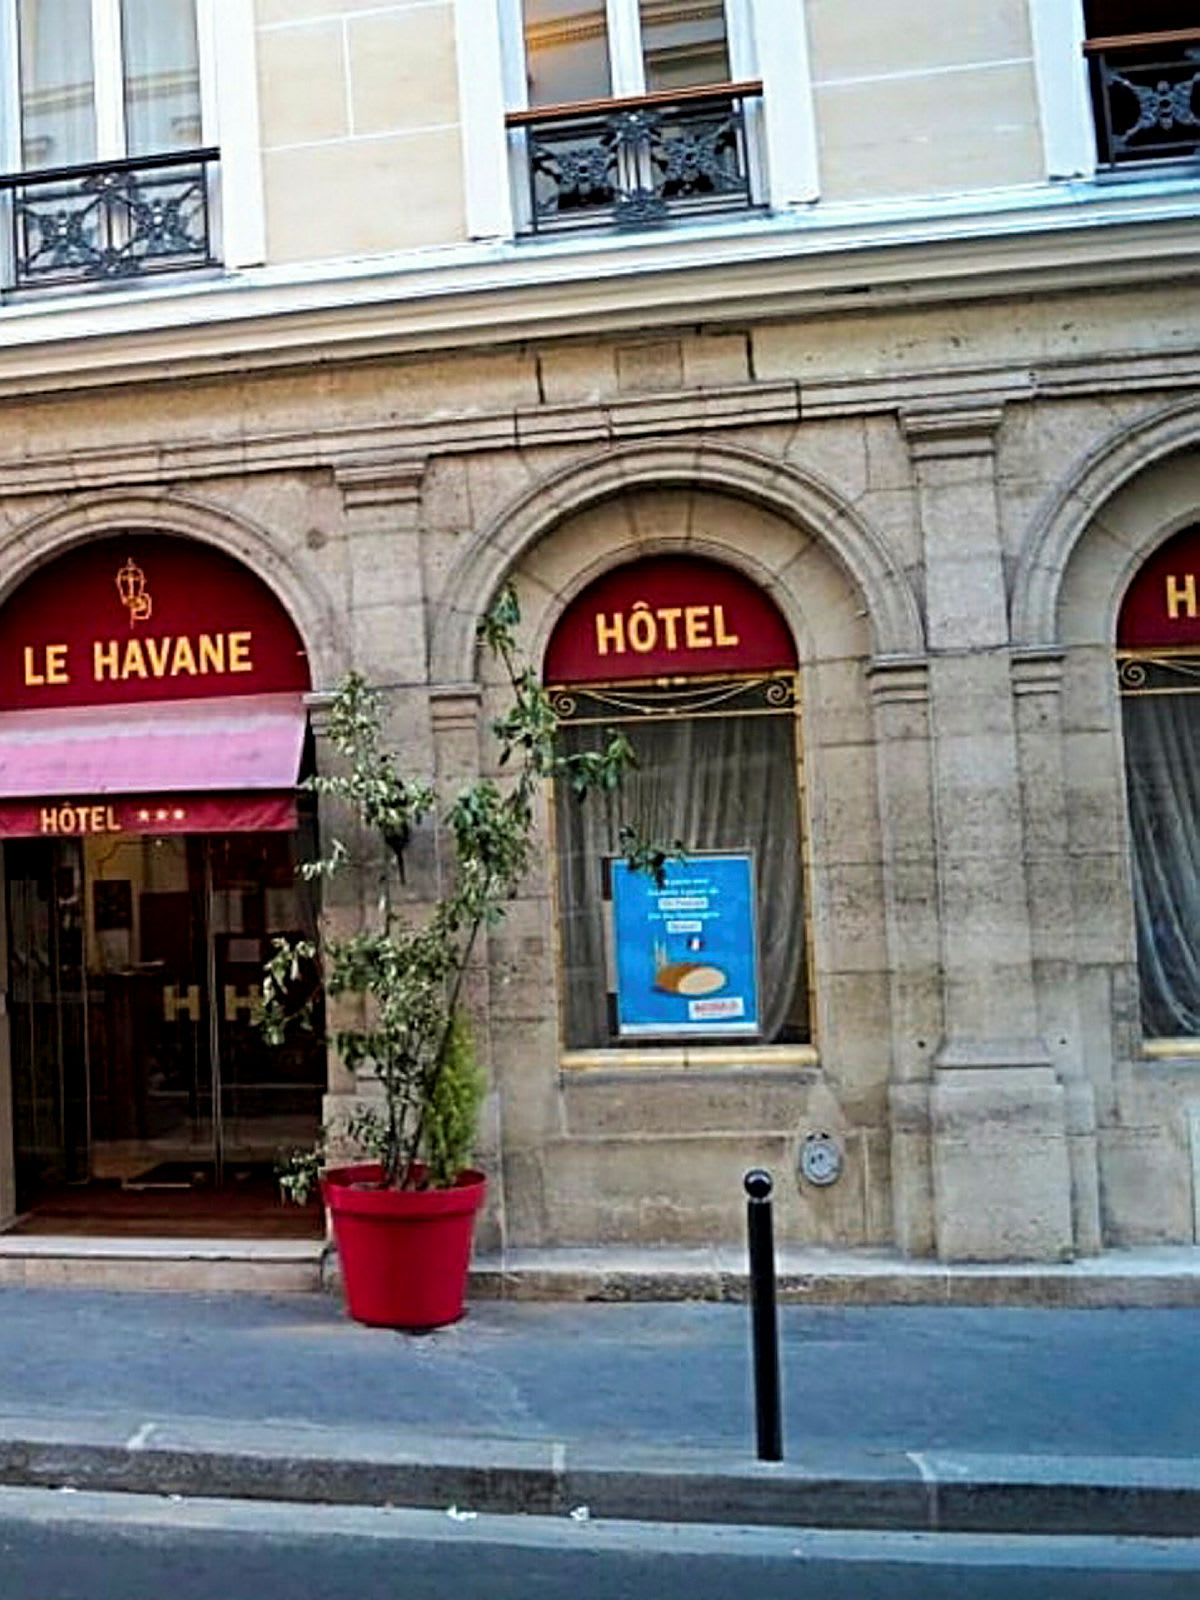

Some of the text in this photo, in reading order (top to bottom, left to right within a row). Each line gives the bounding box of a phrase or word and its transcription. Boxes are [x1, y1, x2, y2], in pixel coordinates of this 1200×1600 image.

[595, 600, 740, 656] HÔTEL
[24, 631, 253, 686] LE HAVANE
[40, 801, 122, 834] HÔTEL
